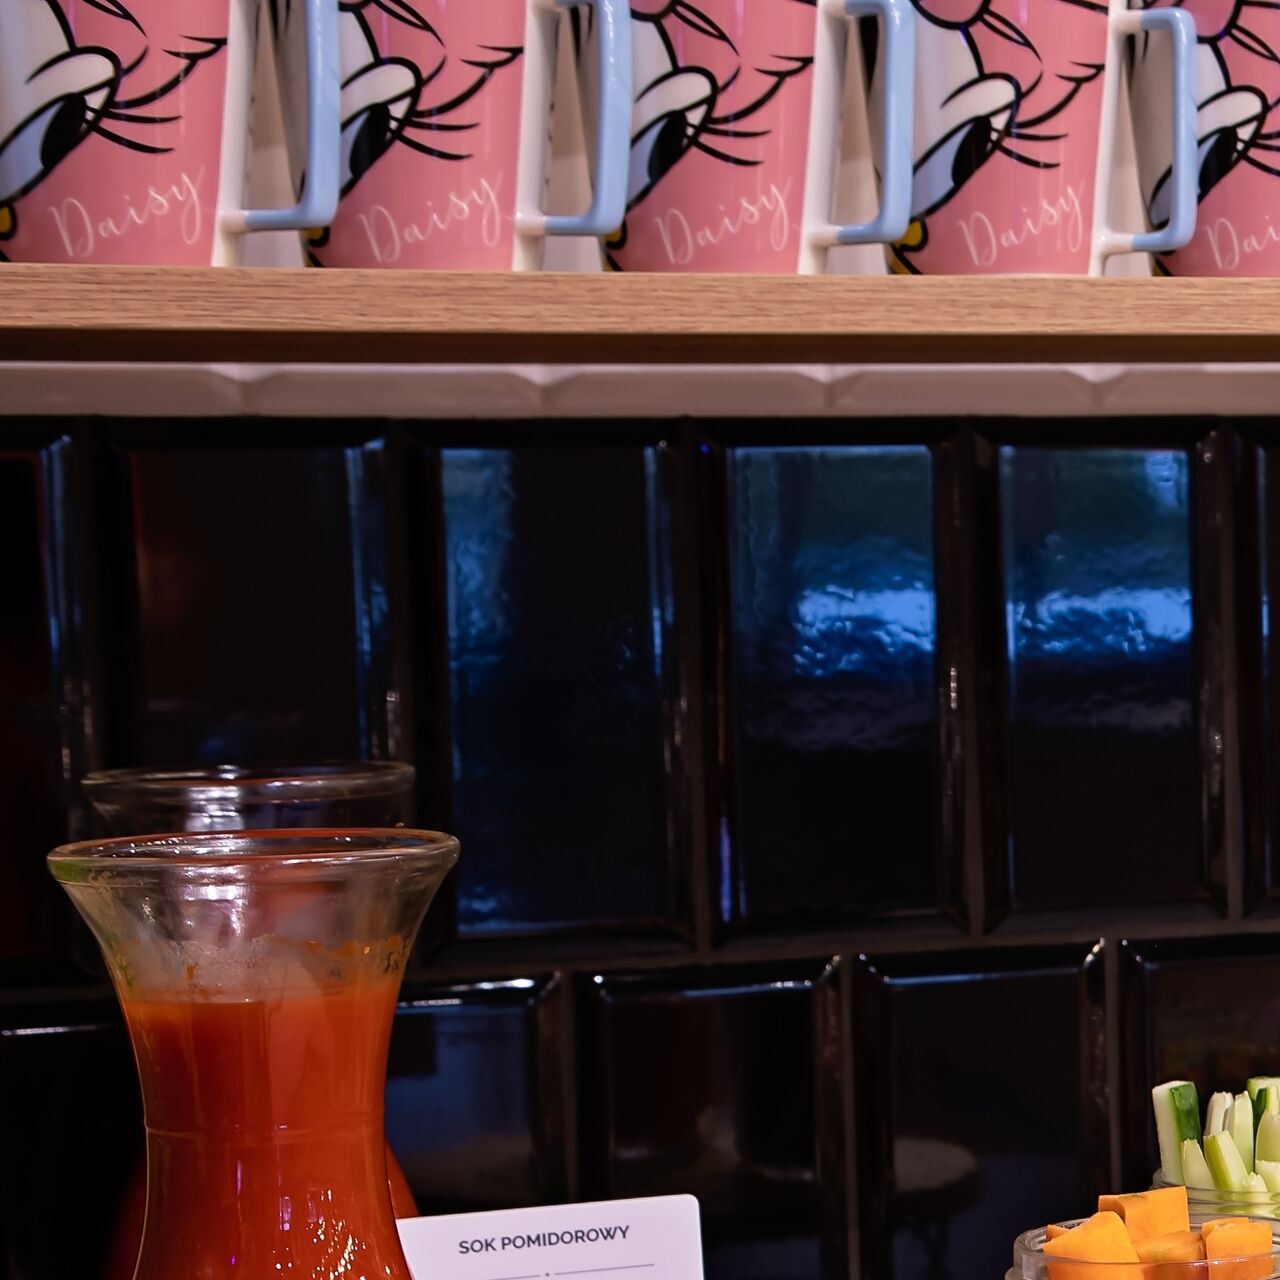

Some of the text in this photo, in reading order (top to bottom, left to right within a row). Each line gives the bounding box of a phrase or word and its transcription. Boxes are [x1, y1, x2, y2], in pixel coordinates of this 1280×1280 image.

[48, 165, 206, 257] Daisy
[356, 170, 503, 262] Daisy
[653, 175, 791, 265] Daisy
[957, 178, 1086, 267] Daisy
[458, 1225, 630, 1255] SOK POMIDOROWY
